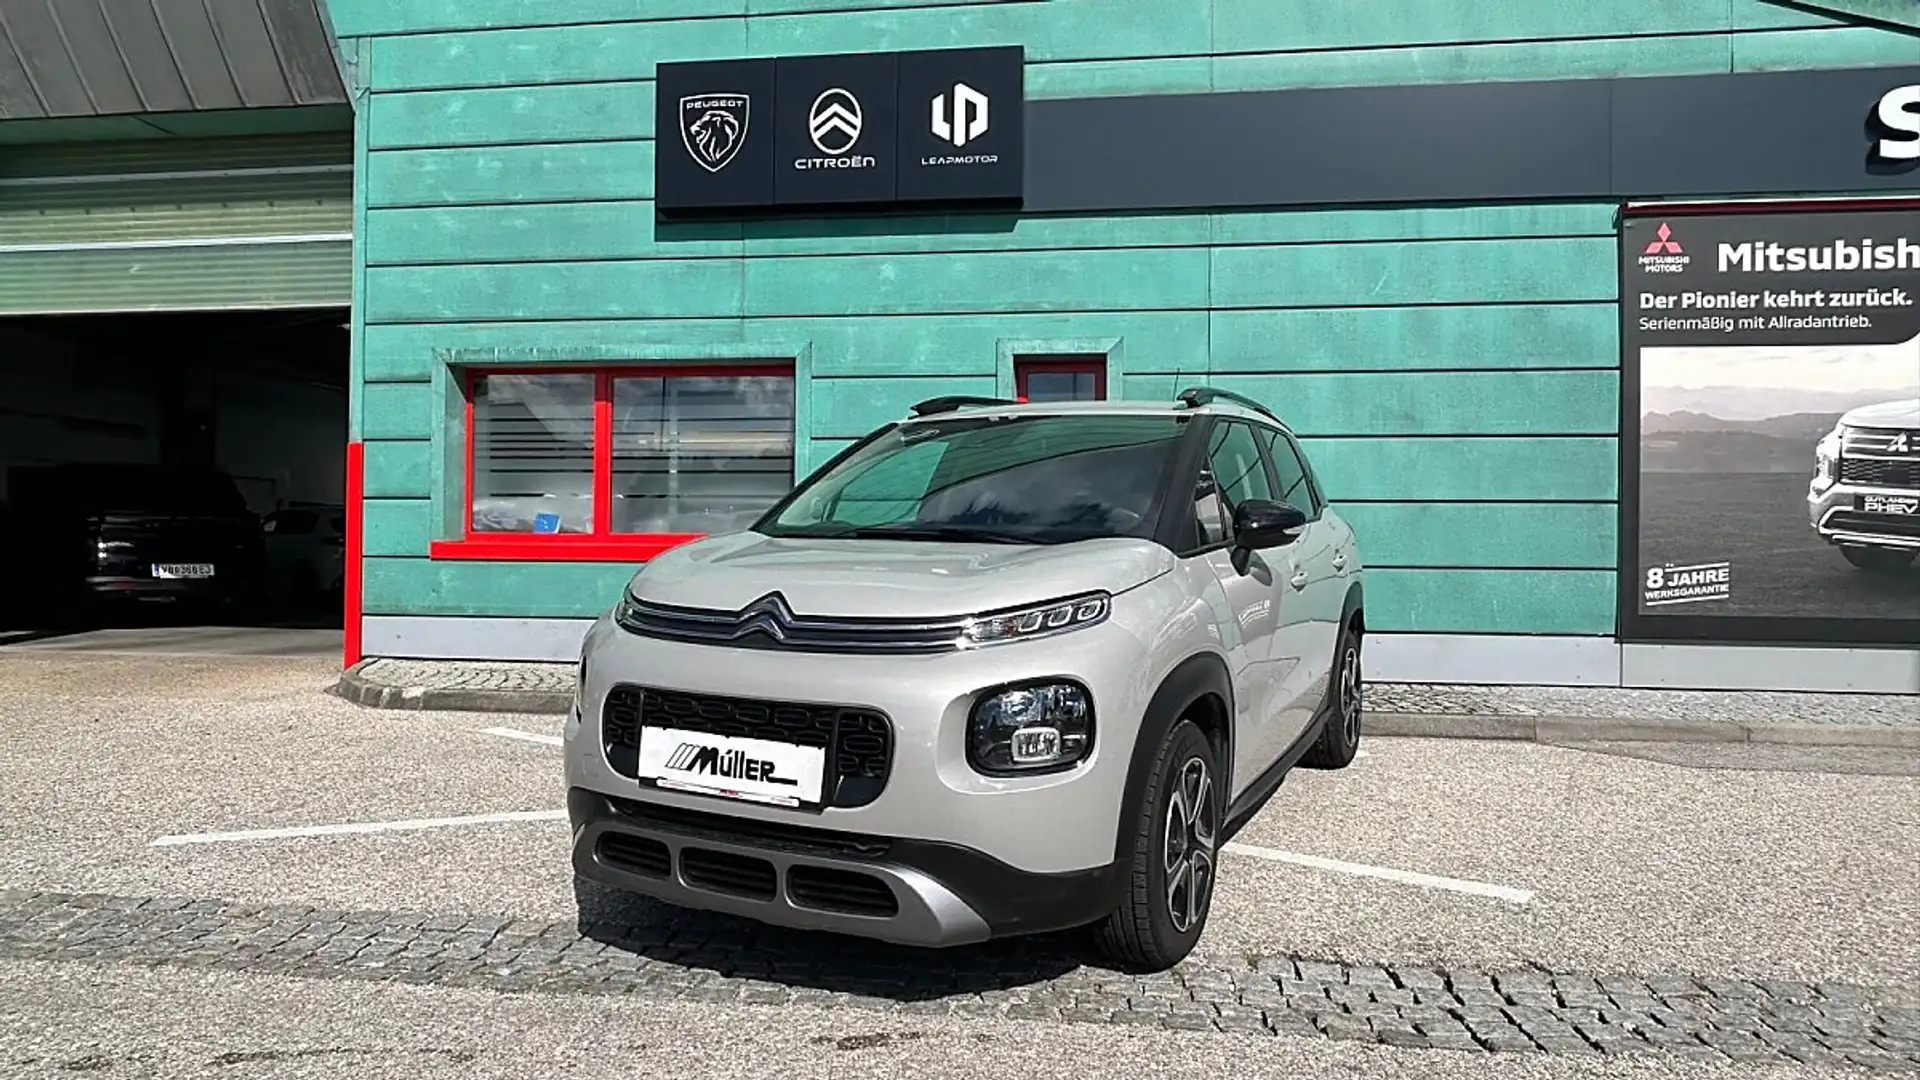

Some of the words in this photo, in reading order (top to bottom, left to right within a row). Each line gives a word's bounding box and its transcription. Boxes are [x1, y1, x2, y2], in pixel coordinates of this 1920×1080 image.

[686, 100, 744, 110] PEUGEOT
[795, 156, 875, 169] CITROËN
[921, 155, 998, 165] LEAPMOTOR
[1638, 256, 1690, 264] MITSUBISHI
[1645, 264, 1683, 273] MOTORS
[1639, 292, 1676, 309] Der
[1681, 290, 1759, 309] Pionier
[1763, 289, 1824, 307] kehrt
[1829, 287, 1913, 306] zurück.
[1639, 315, 1734, 332] Serienmäßig
[1738, 316, 1765, 330] mit
[1768, 314, 1872, 329] Allradantrieb.
[1864, 502, 1918, 514] PHEV
[1646, 567, 1664, 589] 8
[1669, 568, 1730, 587] JAHRE
[1644, 583, 1730, 600] WERKSGARANTIE
